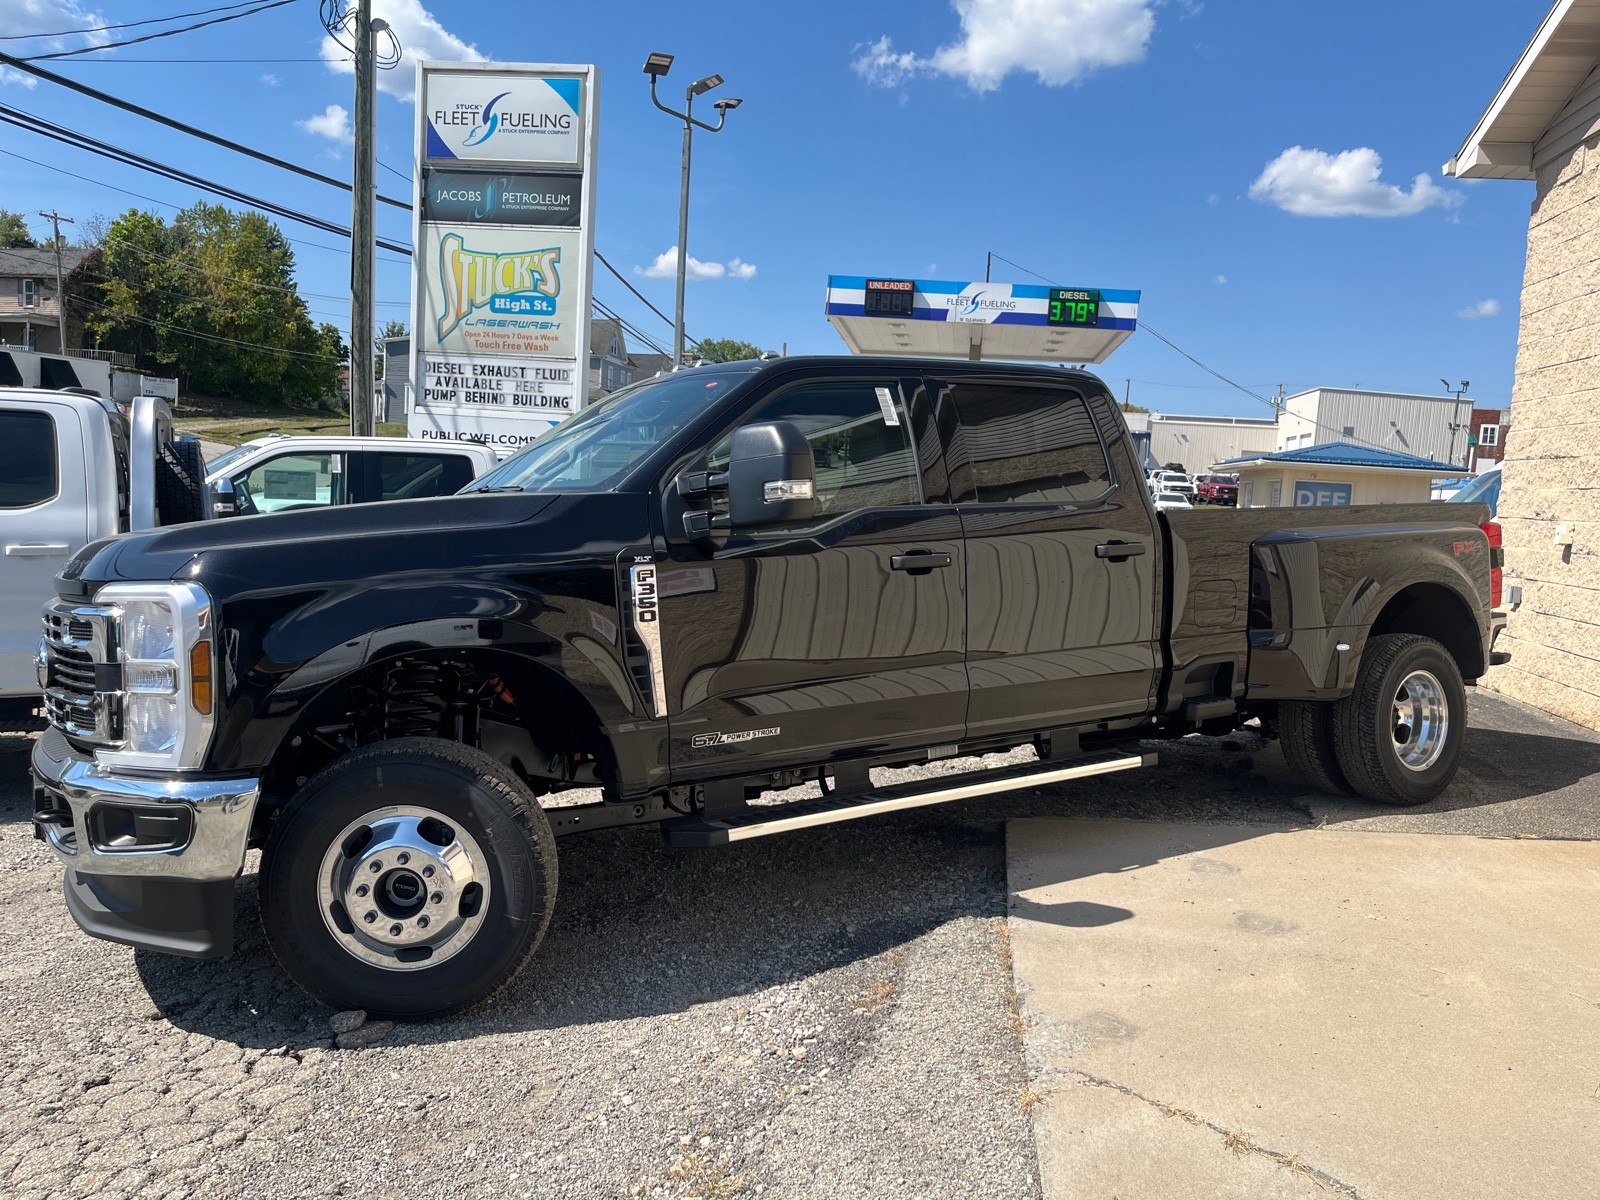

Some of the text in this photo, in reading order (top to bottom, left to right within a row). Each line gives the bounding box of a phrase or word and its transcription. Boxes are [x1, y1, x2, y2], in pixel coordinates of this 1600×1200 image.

[435, 110, 571, 129] FLEET FUELING
[436, 189, 571, 206] JACOBS PETROLEUM
[438, 233, 560, 342] STUCK'S
[869, 280, 911, 290] UNLEADED
[1059, 290, 1090, 301] DIESEL
[494, 298, 553, 312] High St.
[946, 297, 970, 306] FLEET
[980, 299, 1016, 309] FUELING
[464, 318, 561, 330] LASERWASH
[464, 330, 481, 339] Open
[517, 333, 533, 341] Days
[474, 340, 549, 352] Touch Free Wash
[426, 362, 569, 381] DIESEL EXHAUST FLUID
[435, 375, 544, 393] AVAILABLE HERE
[424, 388, 569, 409] PUMP BEHIND BUILDING
[421, 430, 468, 441] PUBLIC
[633, 555, 652, 563] XLT
[637, 569, 656, 623] F350
[726, 731, 751, 741] POWER
[752, 727, 779, 737] STROKE
